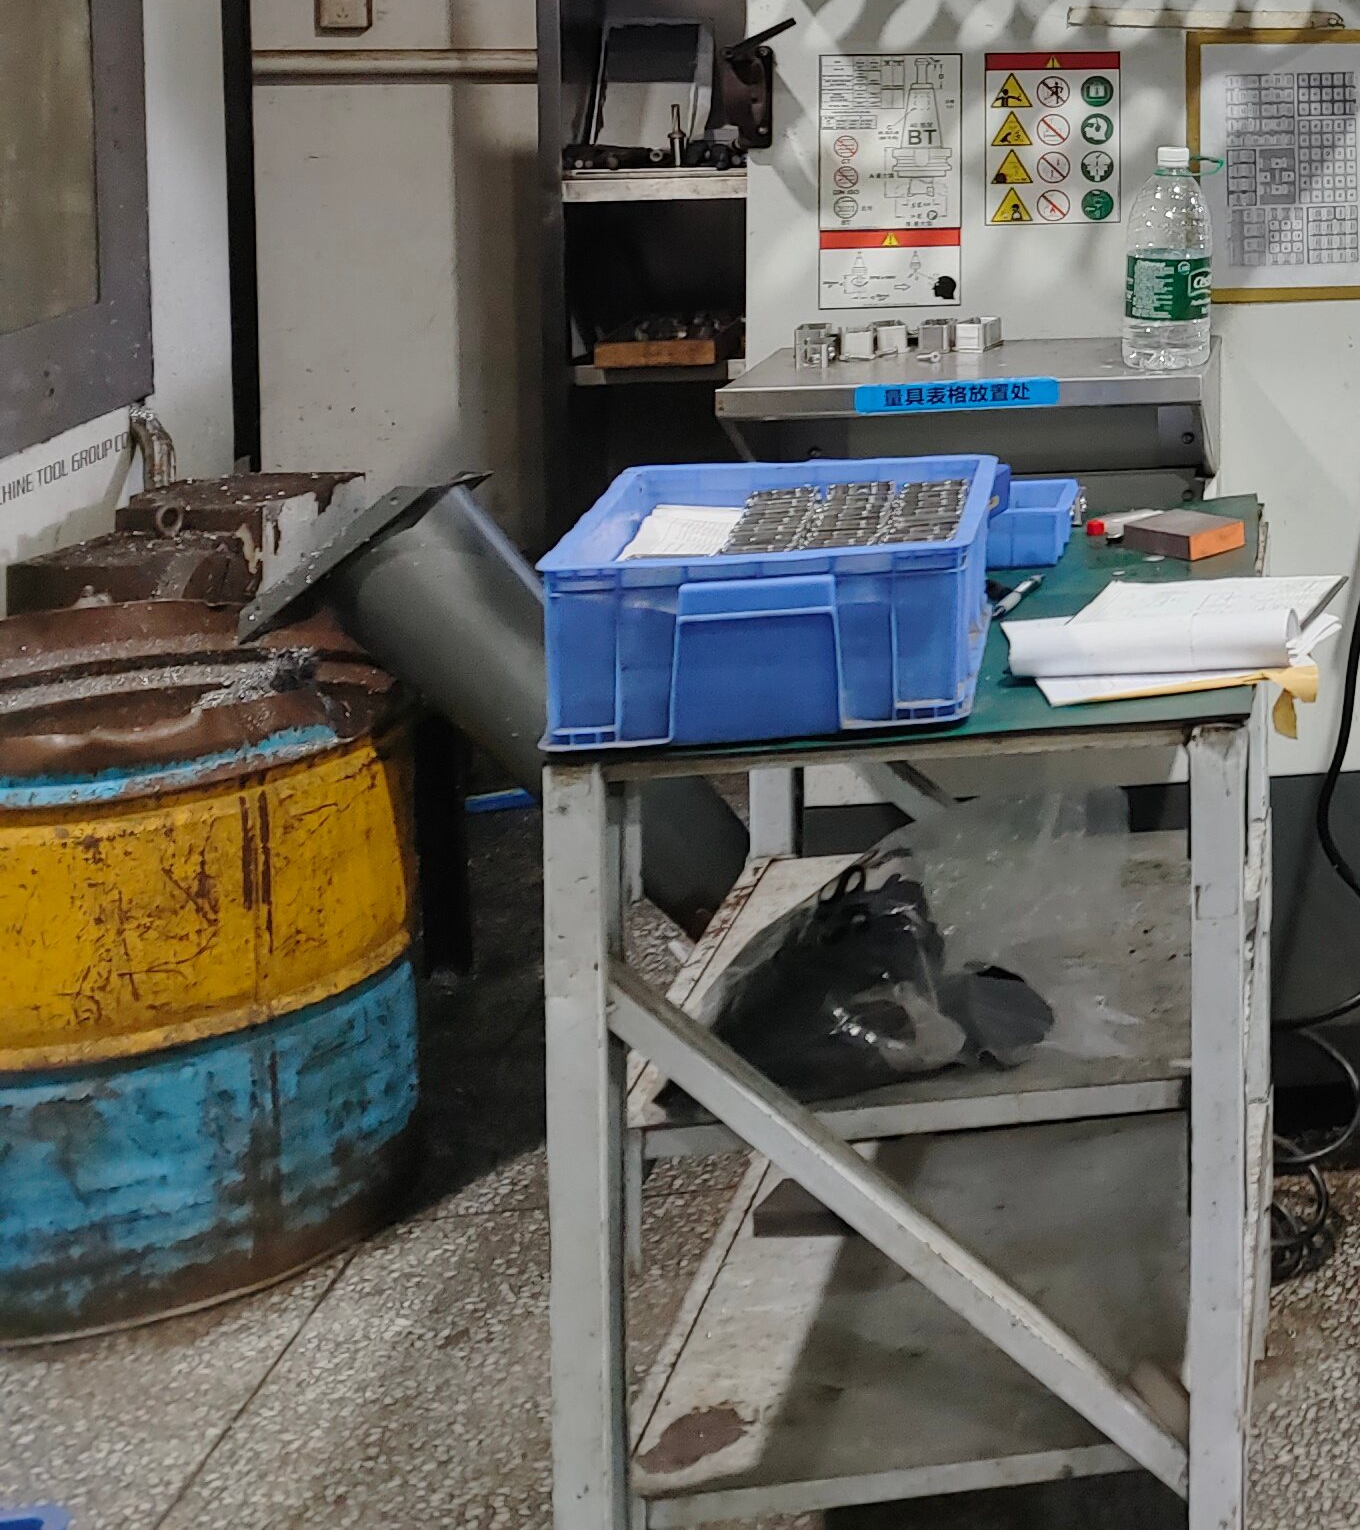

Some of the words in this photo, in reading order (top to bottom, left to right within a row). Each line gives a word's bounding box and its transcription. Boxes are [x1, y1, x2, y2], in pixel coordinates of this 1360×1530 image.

[908, 129, 937, 146] BT
[883, 382, 1031, 408] 量具表格放置处
[0, 473, 33, 506] HINE
[36, 459, 68, 487] TOOL
[71, 438, 113, 473] GROUP
